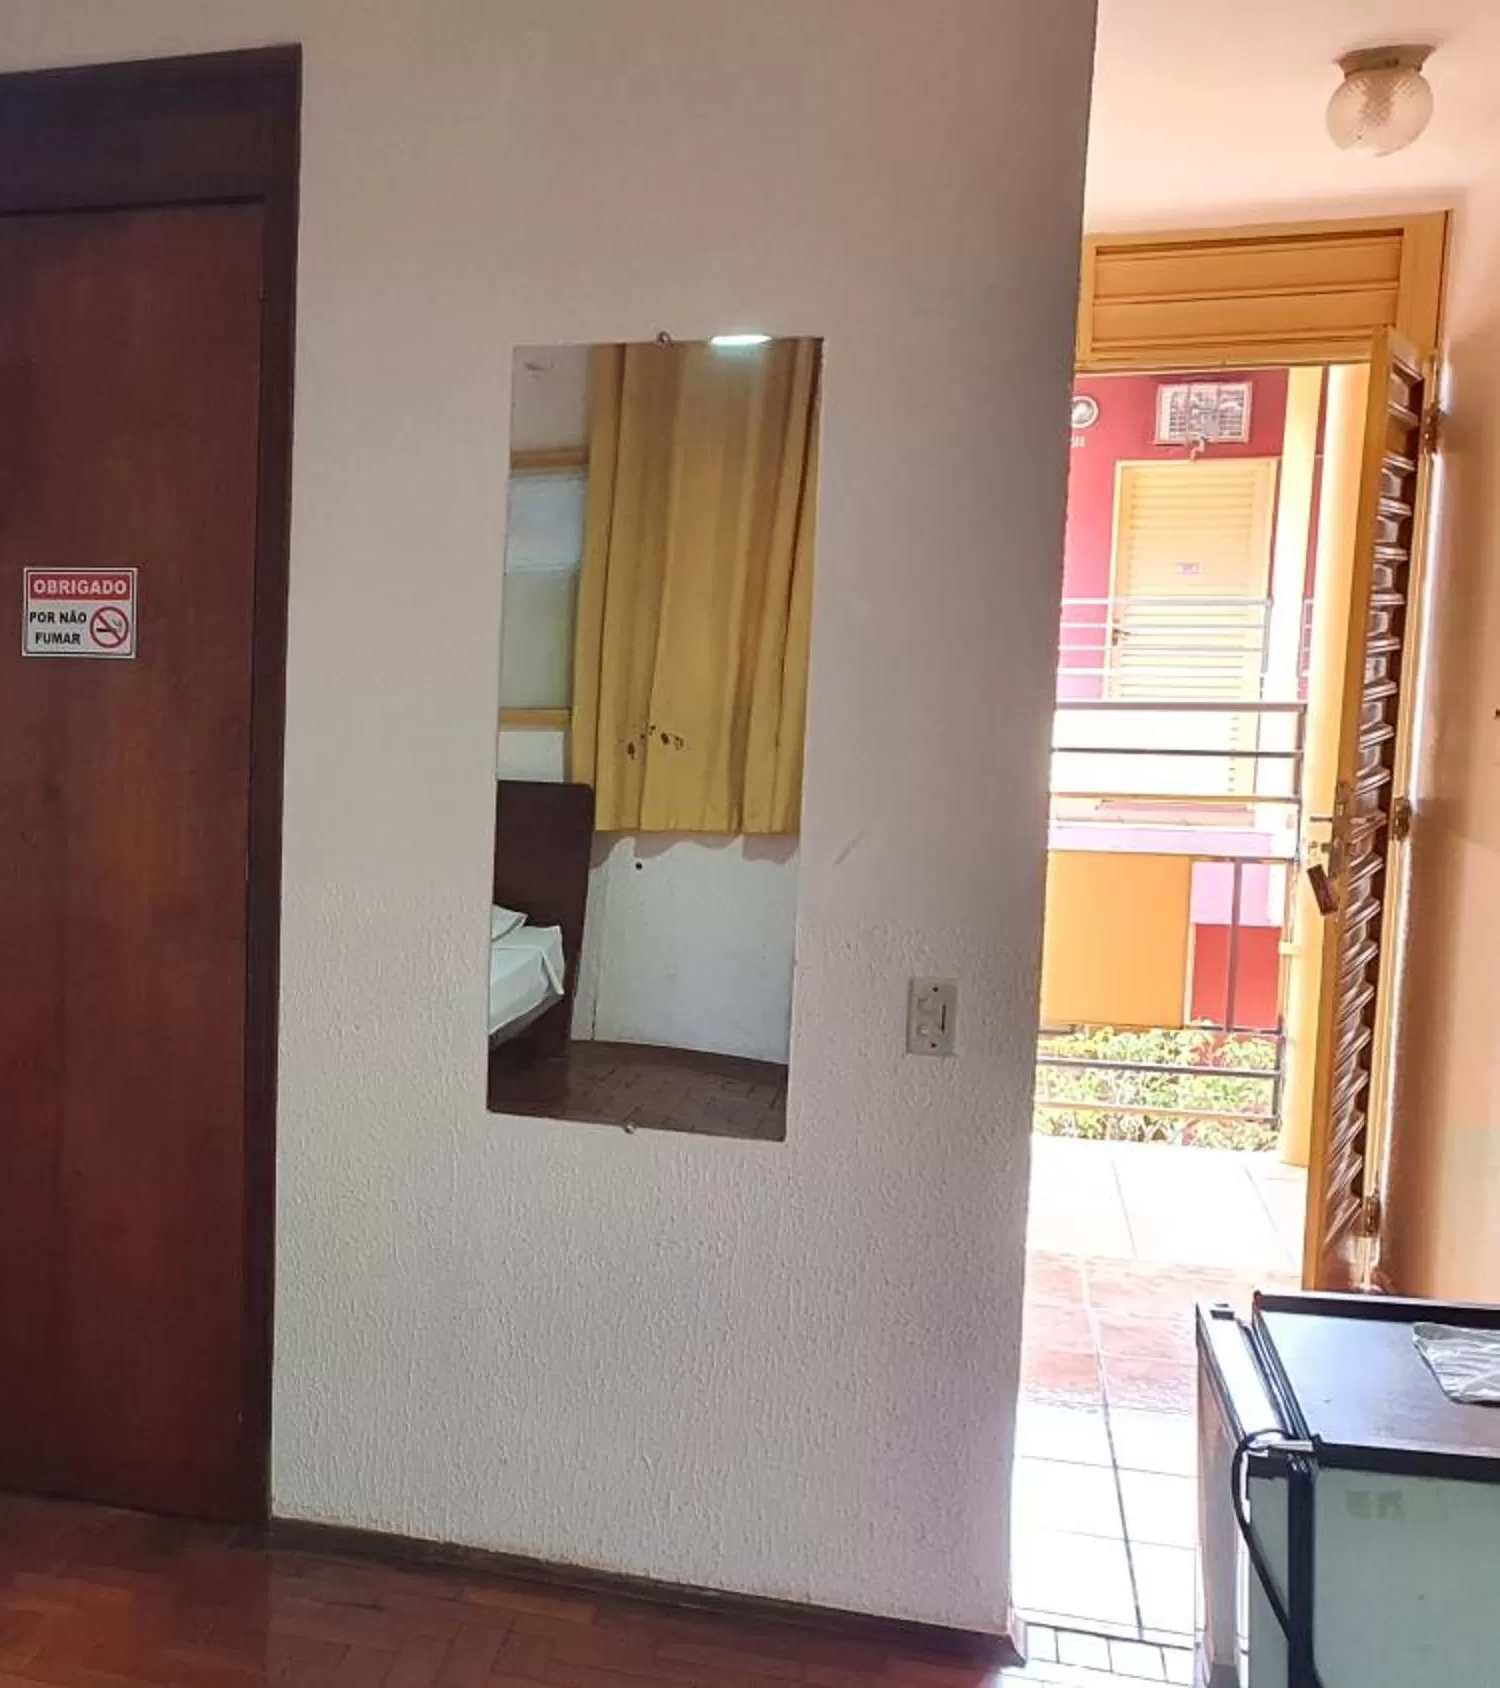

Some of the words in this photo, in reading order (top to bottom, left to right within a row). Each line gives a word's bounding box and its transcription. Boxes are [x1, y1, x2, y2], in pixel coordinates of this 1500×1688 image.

[33, 579, 127, 595] OBRIGADO
[29, 611, 55, 623] POR
[59, 609, 87, 624] NÃO
[35, 631, 81, 645] FUMAR
